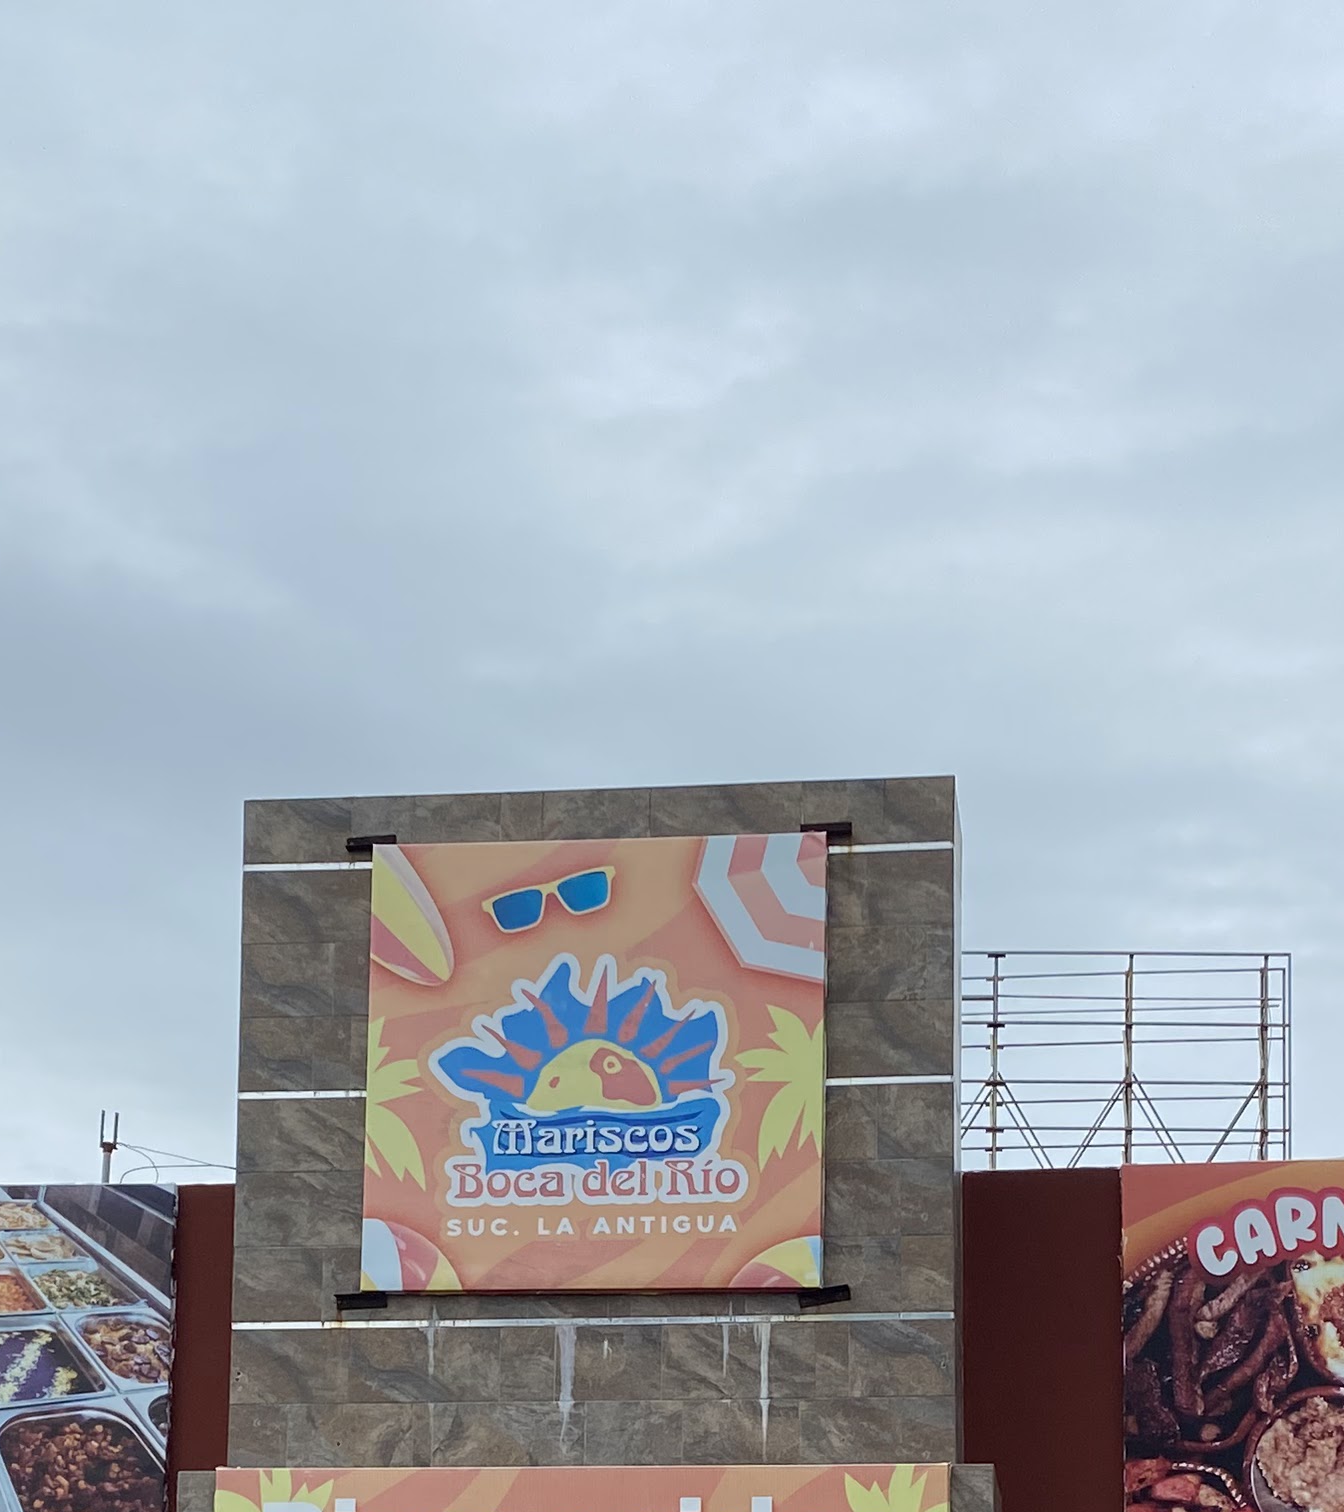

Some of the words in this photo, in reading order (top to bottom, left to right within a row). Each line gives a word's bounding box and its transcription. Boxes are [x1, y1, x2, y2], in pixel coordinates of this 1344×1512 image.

[492, 1119, 701, 1156] Mariscos
[453, 1162, 566, 1200] Boca
[581, 1160, 648, 1198] del
[666, 1159, 740, 1197] Río
[446, 1217, 519, 1238] SUC.
[537, 1217, 575, 1236] LA
[592, 1214, 737, 1234] ANTIGUA
